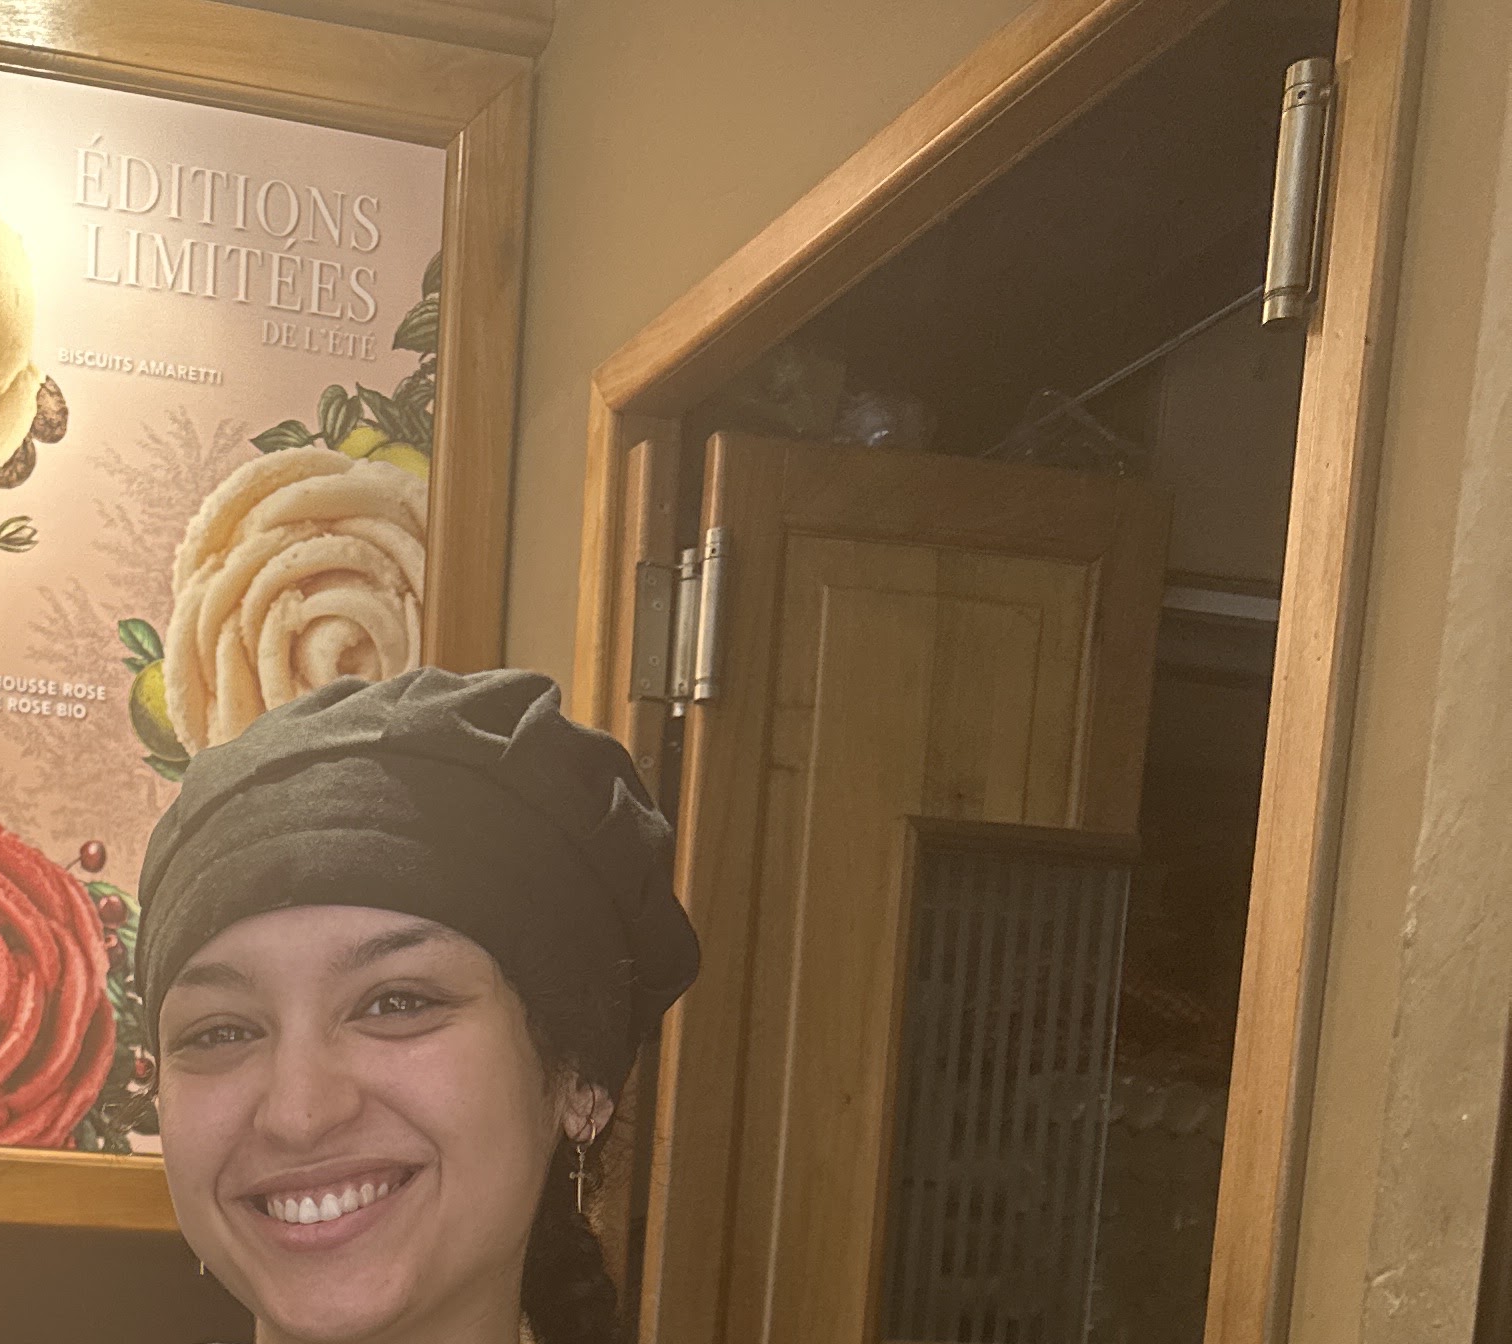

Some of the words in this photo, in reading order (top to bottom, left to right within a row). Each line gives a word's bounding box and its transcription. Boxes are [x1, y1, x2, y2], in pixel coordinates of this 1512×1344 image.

[73, 133, 382, 255] ÉDITIONS
[84, 220, 379, 325] LIMITÉES
[262, 320, 297, 347] DE
[57, 349, 133, 373] BISCUITS
[138, 360, 223, 386] AMARETTI
[62, 682, 106, 700] ROSE
[7, 697, 51, 715] ROSE
[56, 702, 86, 719] BIO
